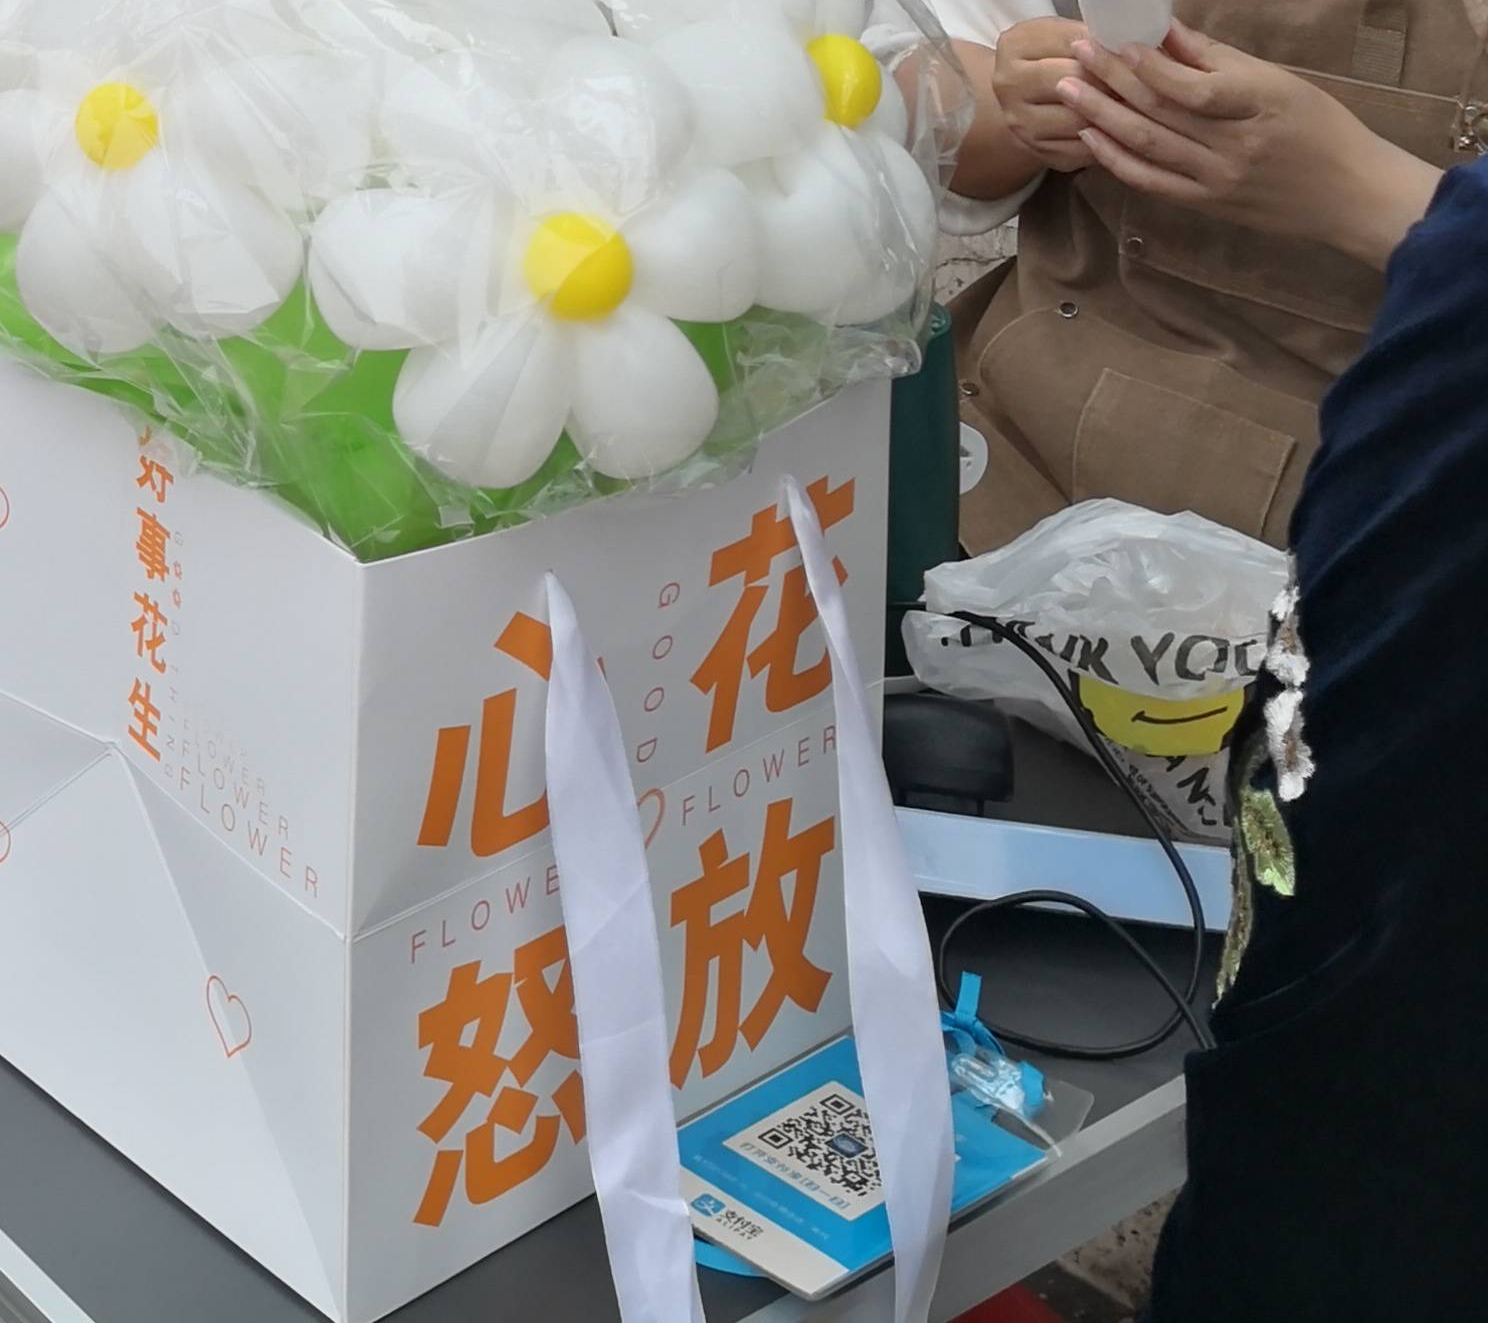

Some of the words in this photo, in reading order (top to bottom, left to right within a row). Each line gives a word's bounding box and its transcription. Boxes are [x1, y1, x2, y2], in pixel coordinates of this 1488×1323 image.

[635, 581, 681, 763] GOOD
[179, 765, 319, 899] FLOWER
[411, 863, 561, 964] FLOWE
[682, 724, 837, 826] FLOWER
[723, 1208, 764, 1238] 支付宝
